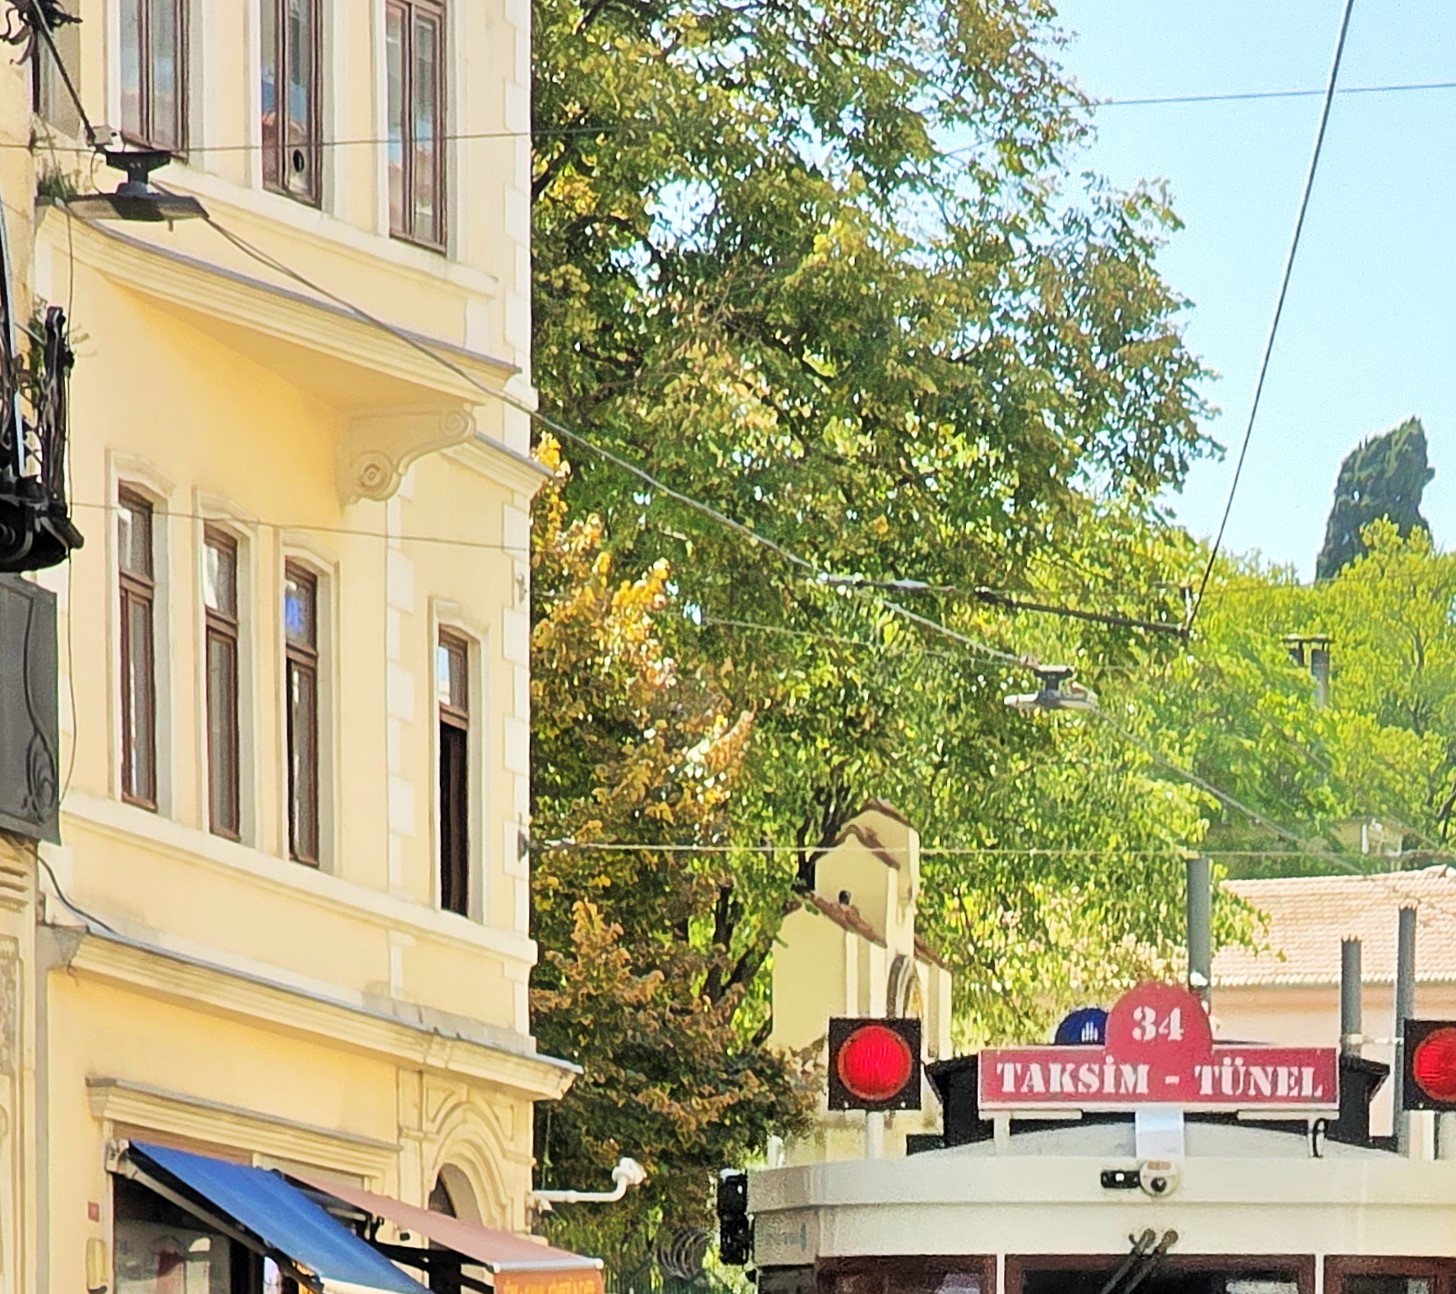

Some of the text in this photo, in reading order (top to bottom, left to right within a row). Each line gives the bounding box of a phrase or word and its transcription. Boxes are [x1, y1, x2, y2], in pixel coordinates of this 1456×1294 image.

[1132, 1006, 1184, 1042] 34
[996, 1056, 1150, 1095] TAKSİM
[1194, 1056, 1323, 1098] TÜNEL
